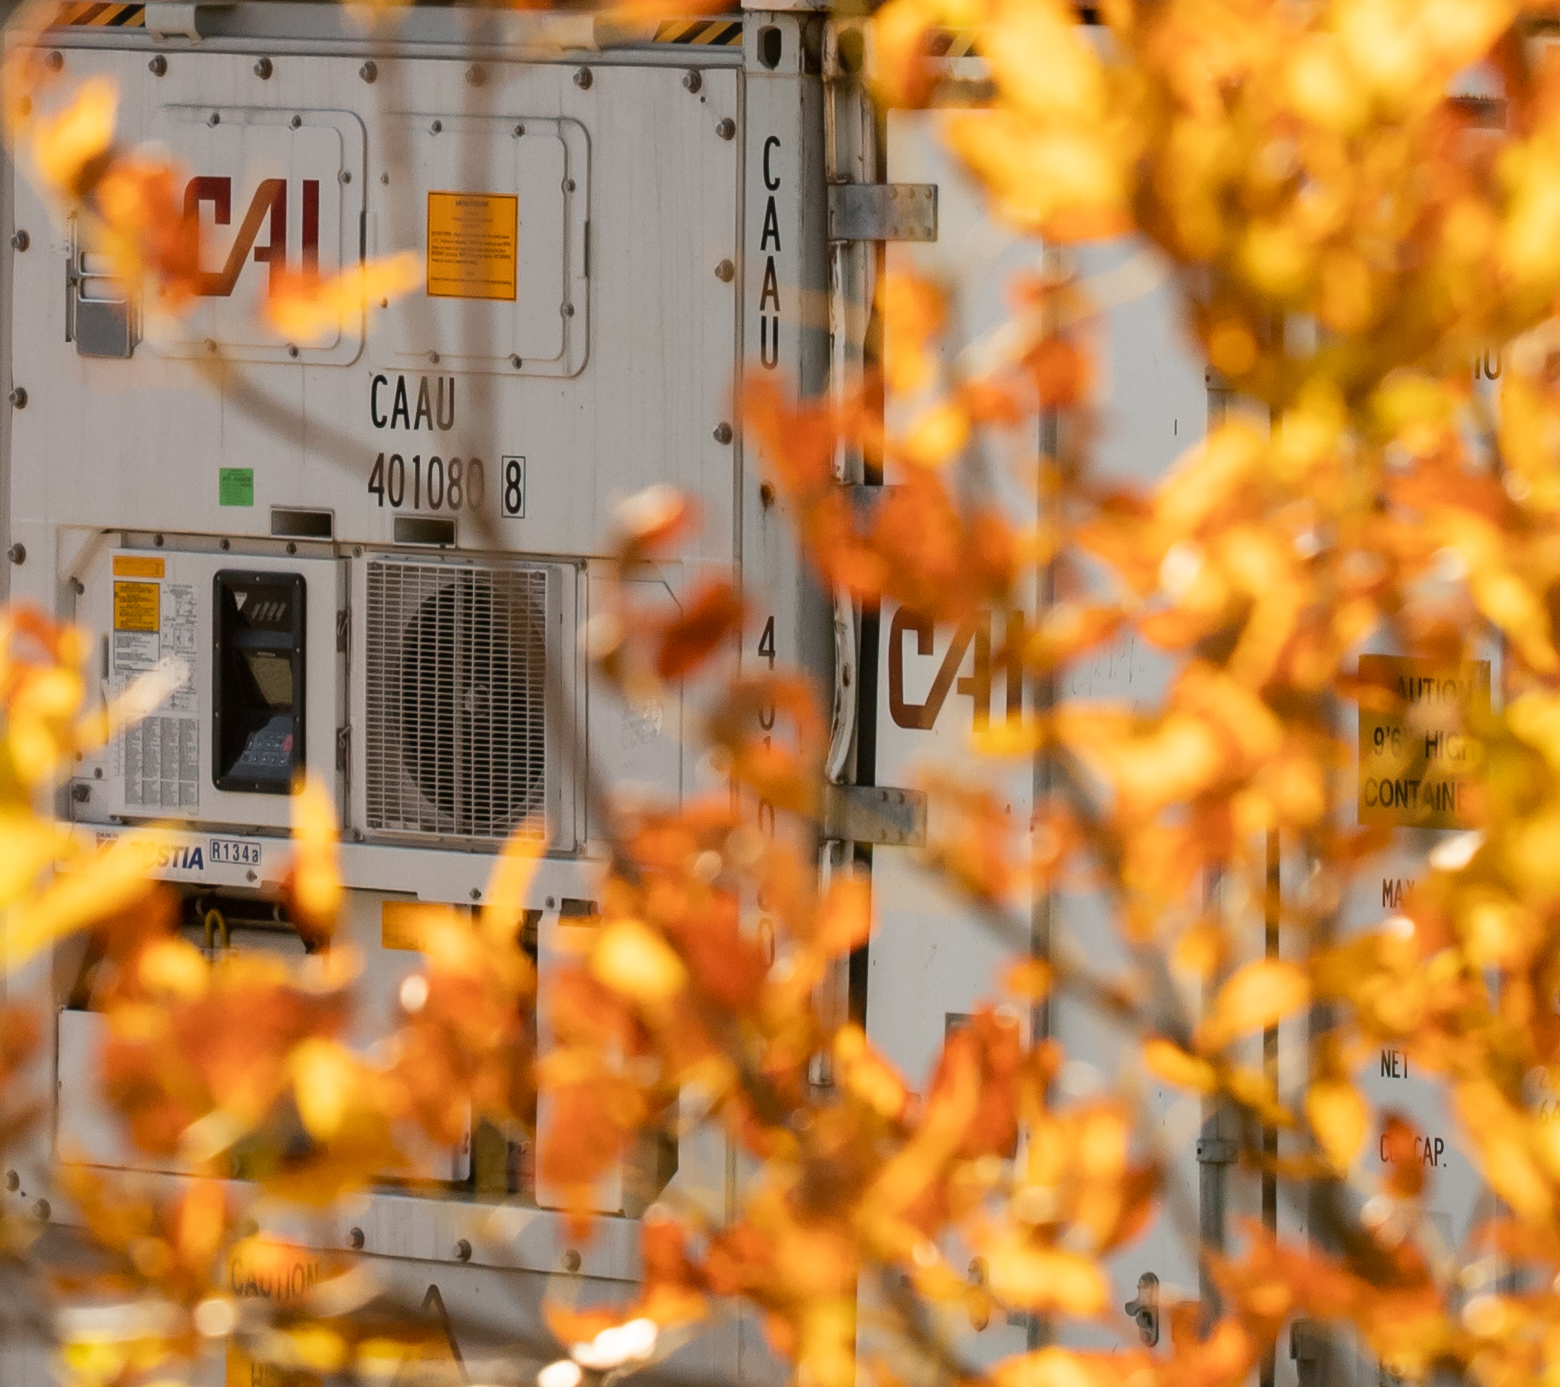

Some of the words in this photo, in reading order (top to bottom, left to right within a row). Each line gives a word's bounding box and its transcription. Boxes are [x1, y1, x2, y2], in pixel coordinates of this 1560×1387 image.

[759, 135, 782, 371] CAAU
[370, 374, 455, 431] CAAU
[367, 452, 485, 511] 401080
[504, 459, 522, 515] 8
[212, 841, 259, 863] R134a
